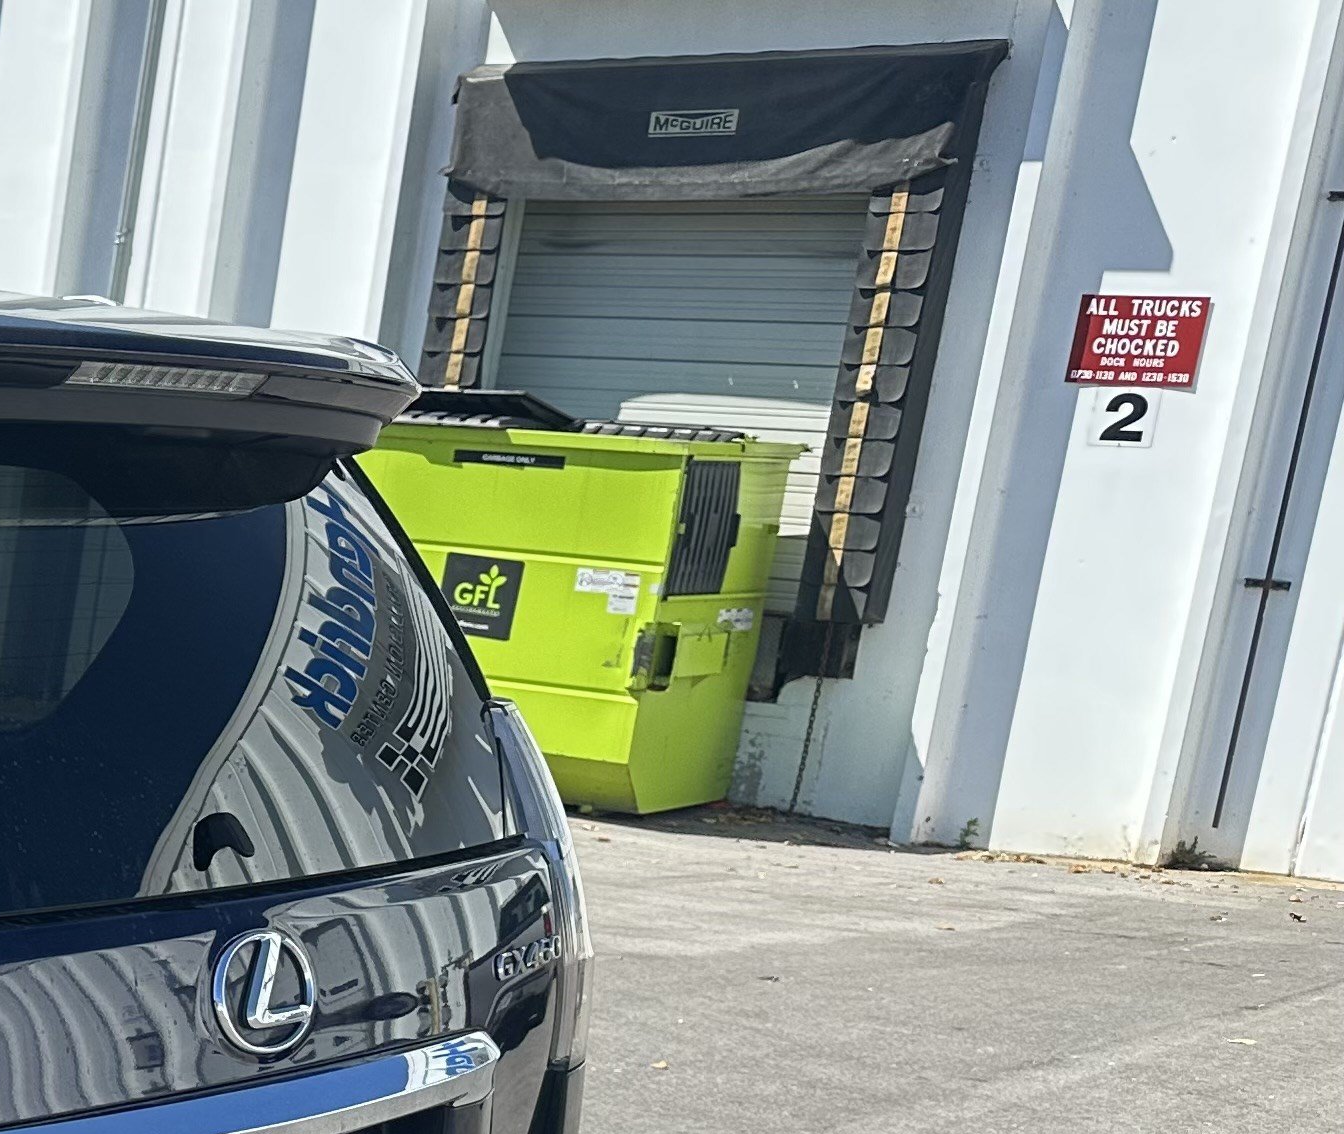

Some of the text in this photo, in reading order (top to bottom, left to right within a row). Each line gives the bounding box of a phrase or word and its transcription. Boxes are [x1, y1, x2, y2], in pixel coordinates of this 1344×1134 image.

[1086, 298, 1203, 317] ALL TRUCKS
[1102, 318, 1179, 337] MUST BE
[1092, 337, 1180, 357] CHOCKED
[1100, 356, 1165, 368] DOCK HOURS
[1099, 393, 1149, 442] 2
[454, 574, 505, 609] GFL
